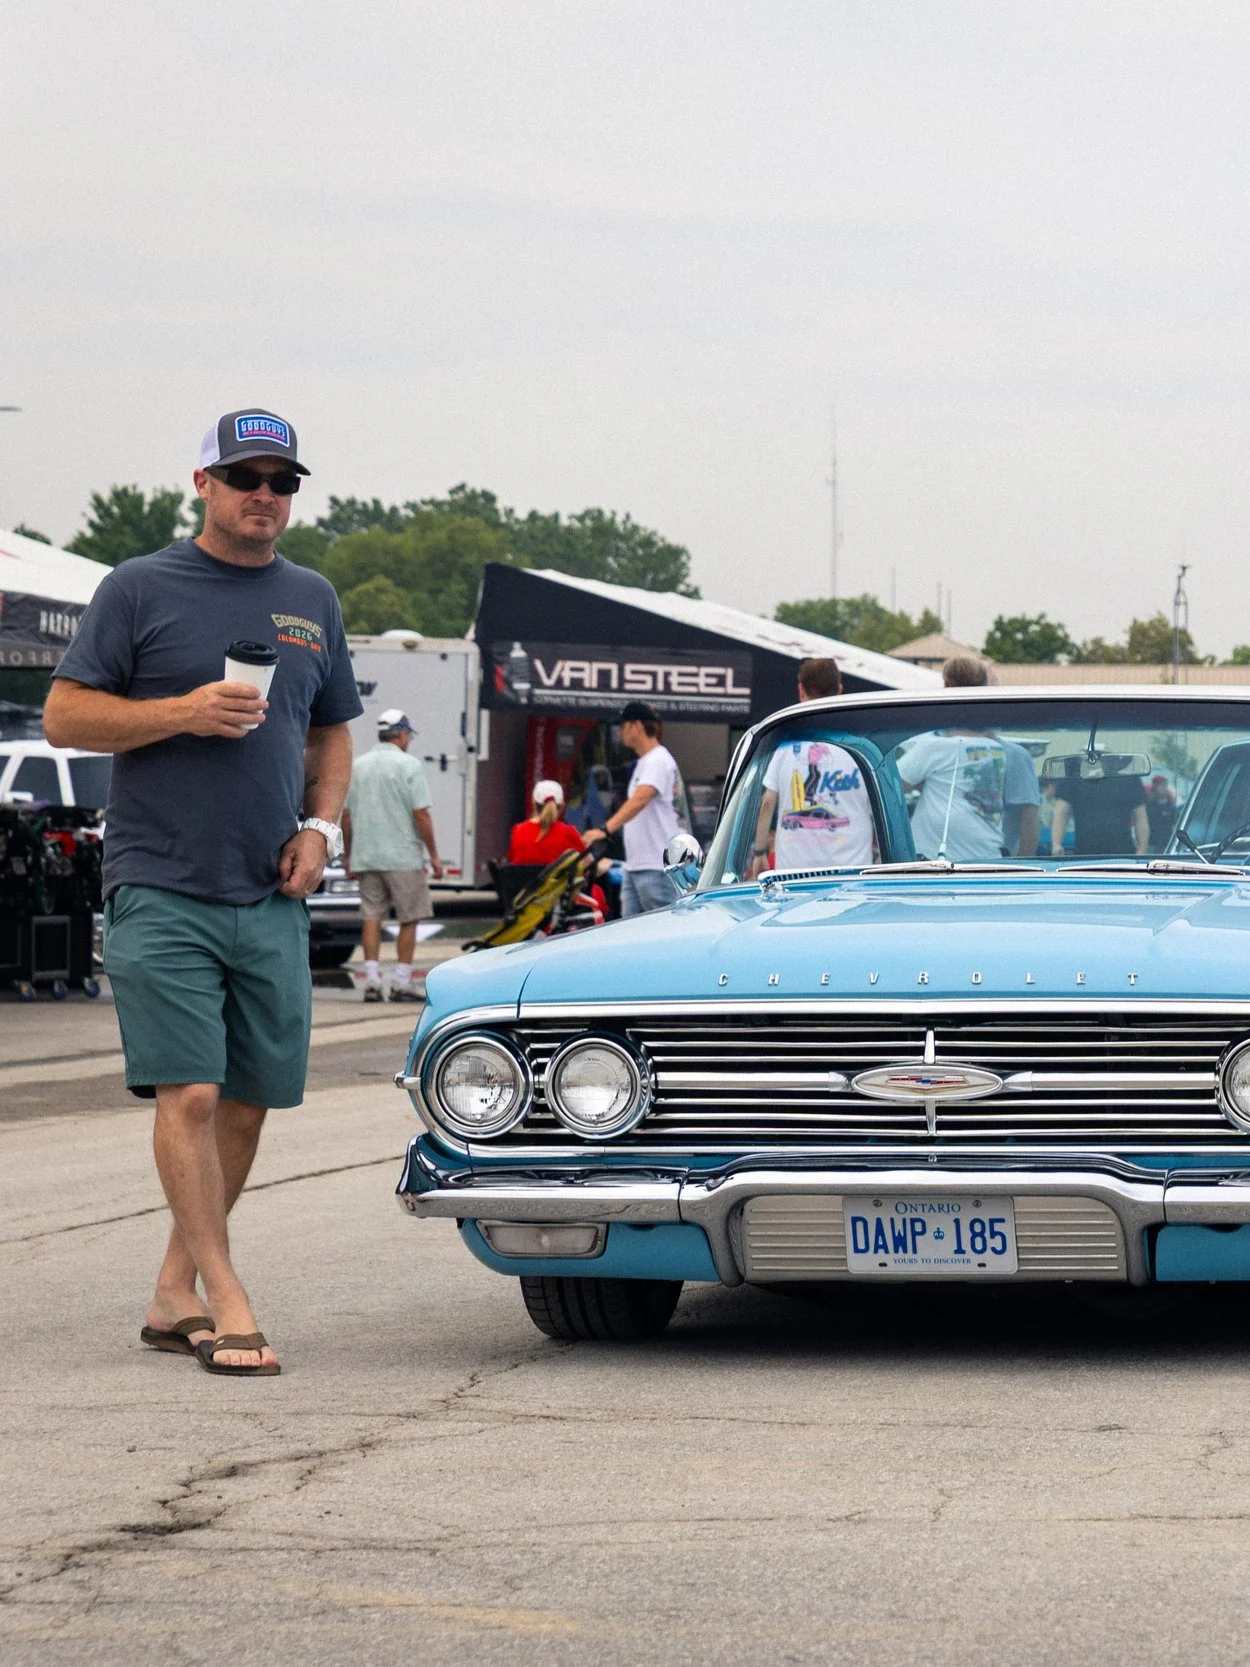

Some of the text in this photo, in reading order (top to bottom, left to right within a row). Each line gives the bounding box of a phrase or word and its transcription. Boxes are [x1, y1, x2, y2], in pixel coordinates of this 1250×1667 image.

[241, 419, 285, 437] GOODGUYS
[271, 613, 322, 638] GOODGUYS
[278, 634, 307, 647] COLUMBUS
[534, 658, 751, 695] VAN STEEL
[819, 768, 860, 793] Kith
[717, 971, 1139, 986] CHEVROLET
[895, 1202, 961, 1215] ONTARIO
[851, 1216, 1007, 1256] DAWP 185
